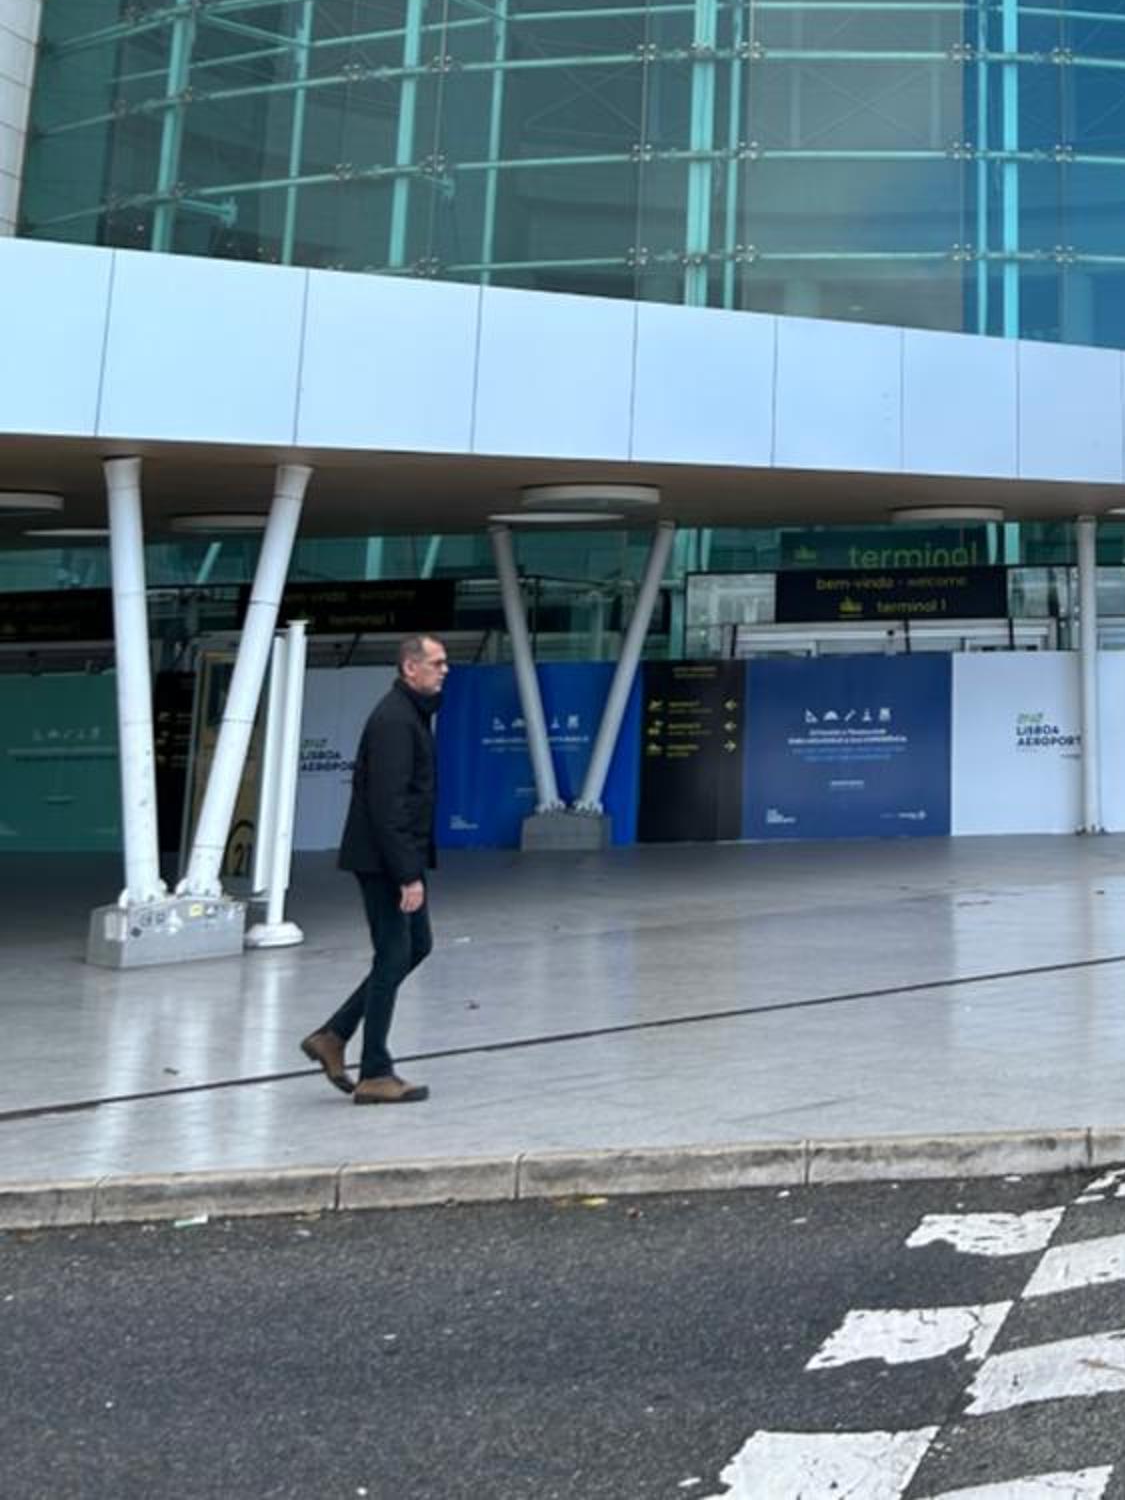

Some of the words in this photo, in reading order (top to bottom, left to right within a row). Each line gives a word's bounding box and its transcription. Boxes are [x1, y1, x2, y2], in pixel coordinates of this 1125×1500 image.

[849, 541, 978, 569] terminal
[876, 599, 938, 613] terminal
[1016, 724, 1059, 736] LISBOA
[1017, 735, 1082, 747] AEROPORT
